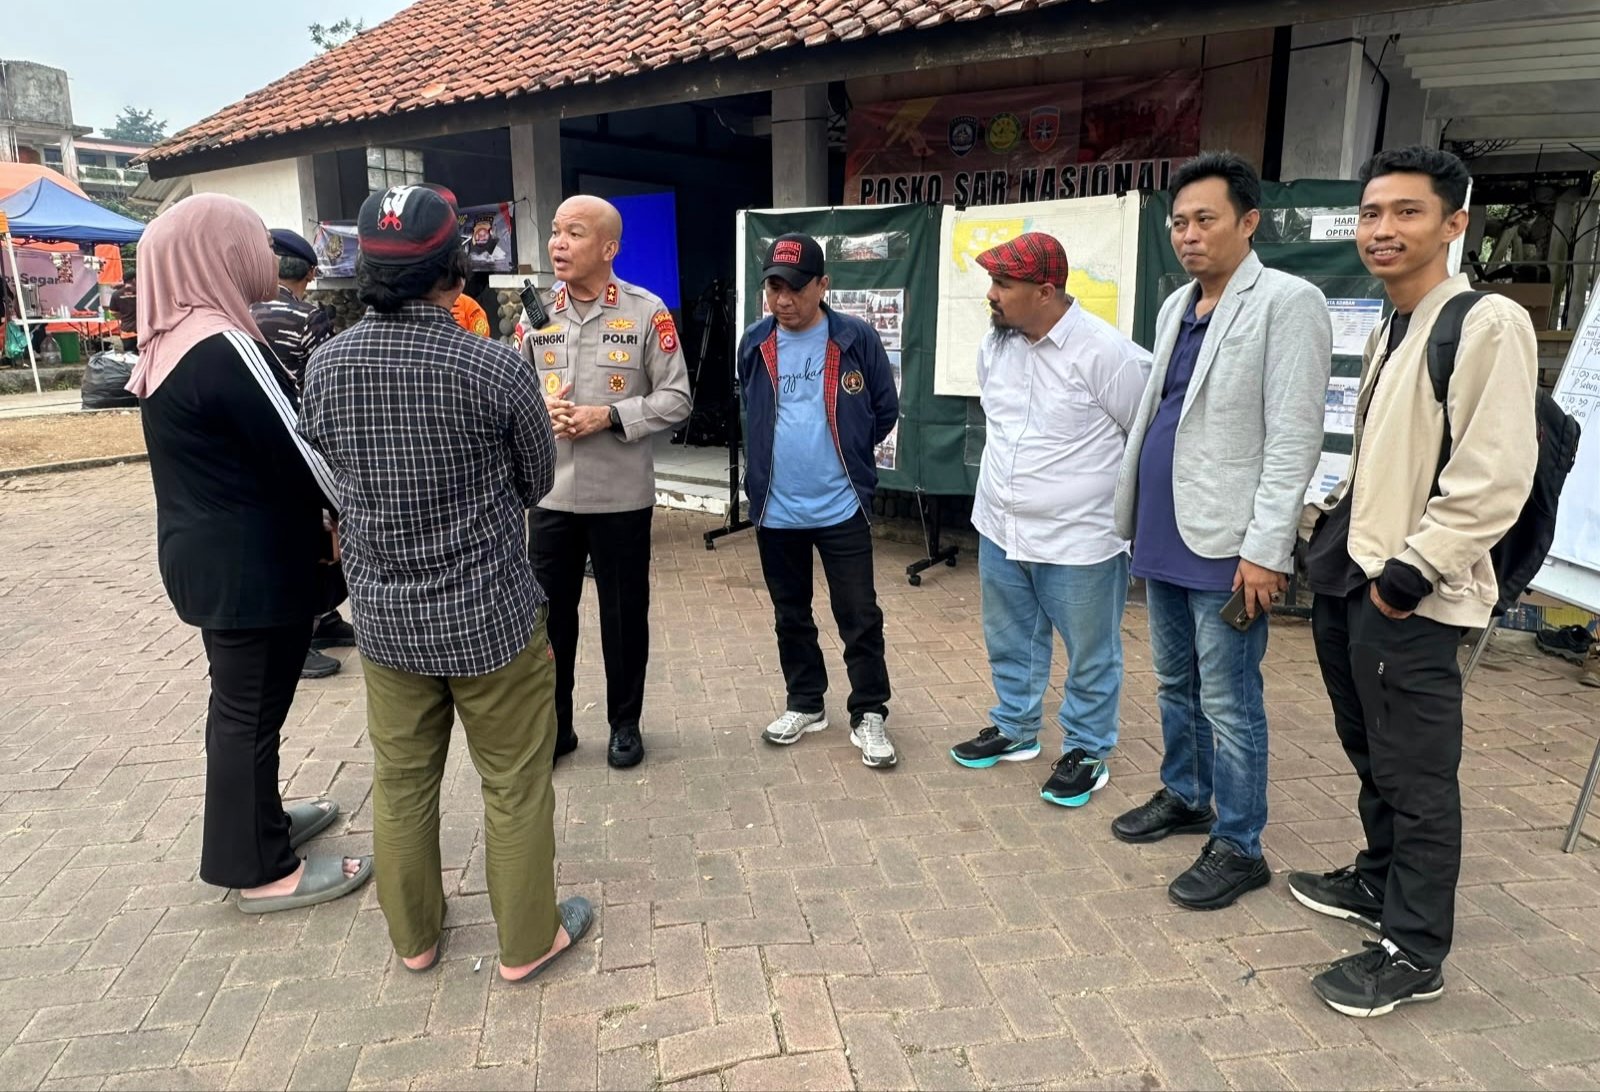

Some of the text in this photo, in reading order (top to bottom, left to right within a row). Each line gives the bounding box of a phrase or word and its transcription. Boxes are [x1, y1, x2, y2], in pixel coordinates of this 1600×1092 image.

[860, 174, 941, 204] POSKO
[953, 170, 1008, 206] SAR
[1334, 217, 1356, 225] HARI
[532, 334, 565, 346] HENGKI
[602, 334, 638, 345] POLRI
